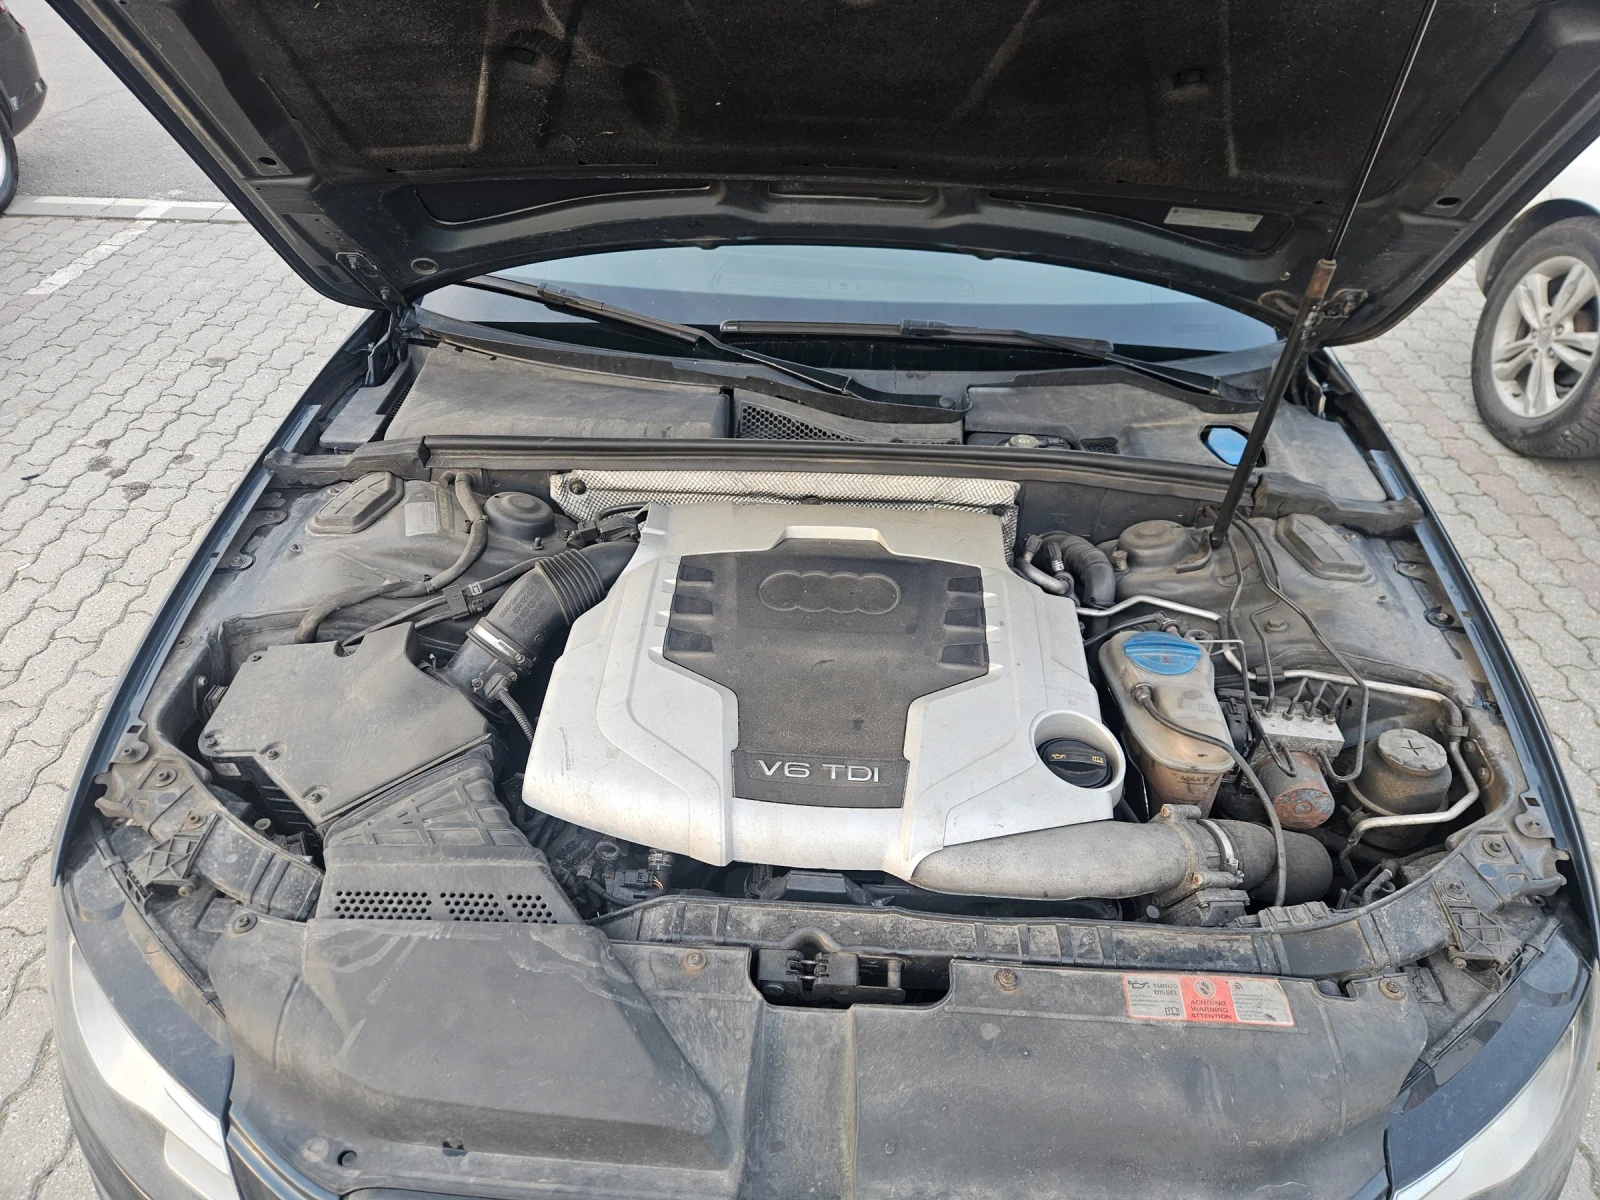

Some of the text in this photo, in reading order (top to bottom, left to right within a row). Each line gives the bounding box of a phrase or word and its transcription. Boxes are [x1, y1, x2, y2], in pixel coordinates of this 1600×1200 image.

[757, 759, 879, 783] V6 TDI
[1180, 775, 1202, 783] MAX
[1191, 1012, 1233, 1020] ATTENTION
